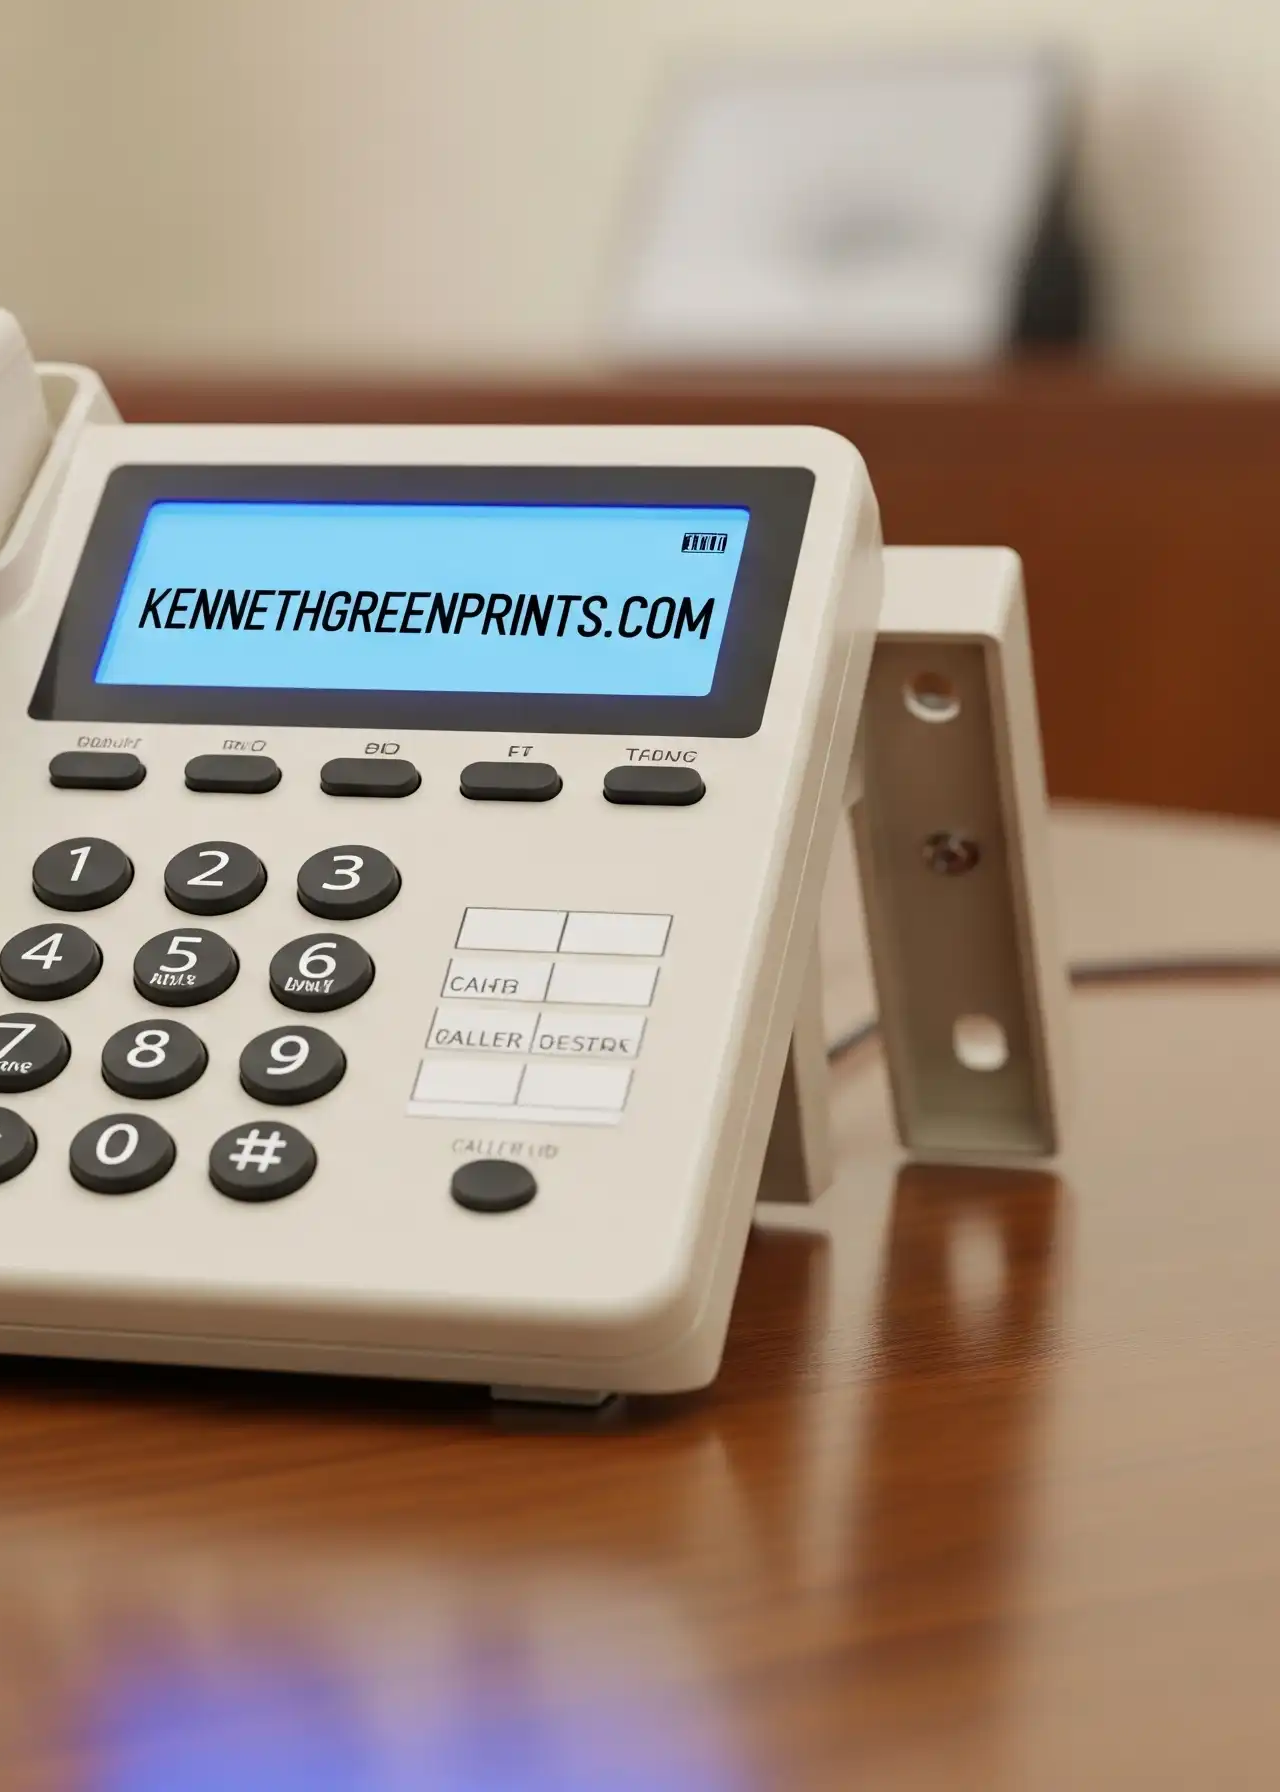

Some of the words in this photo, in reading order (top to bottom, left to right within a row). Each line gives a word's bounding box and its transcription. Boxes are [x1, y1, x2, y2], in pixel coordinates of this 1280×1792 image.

[138, 587, 715, 641] KENNETHGREENPRINTS.COM
[68, 846, 92, 882] 1
[186, 850, 230, 887] 2
[321, 854, 364, 891] 3
[21, 932, 64, 970] 4
[159, 935, 203, 973] 5
[298, 941, 338, 979] 6
[126, 1029, 170, 1069] 8
[266, 1034, 310, 1075] 9
[94, 1122, 139, 1165] 0
